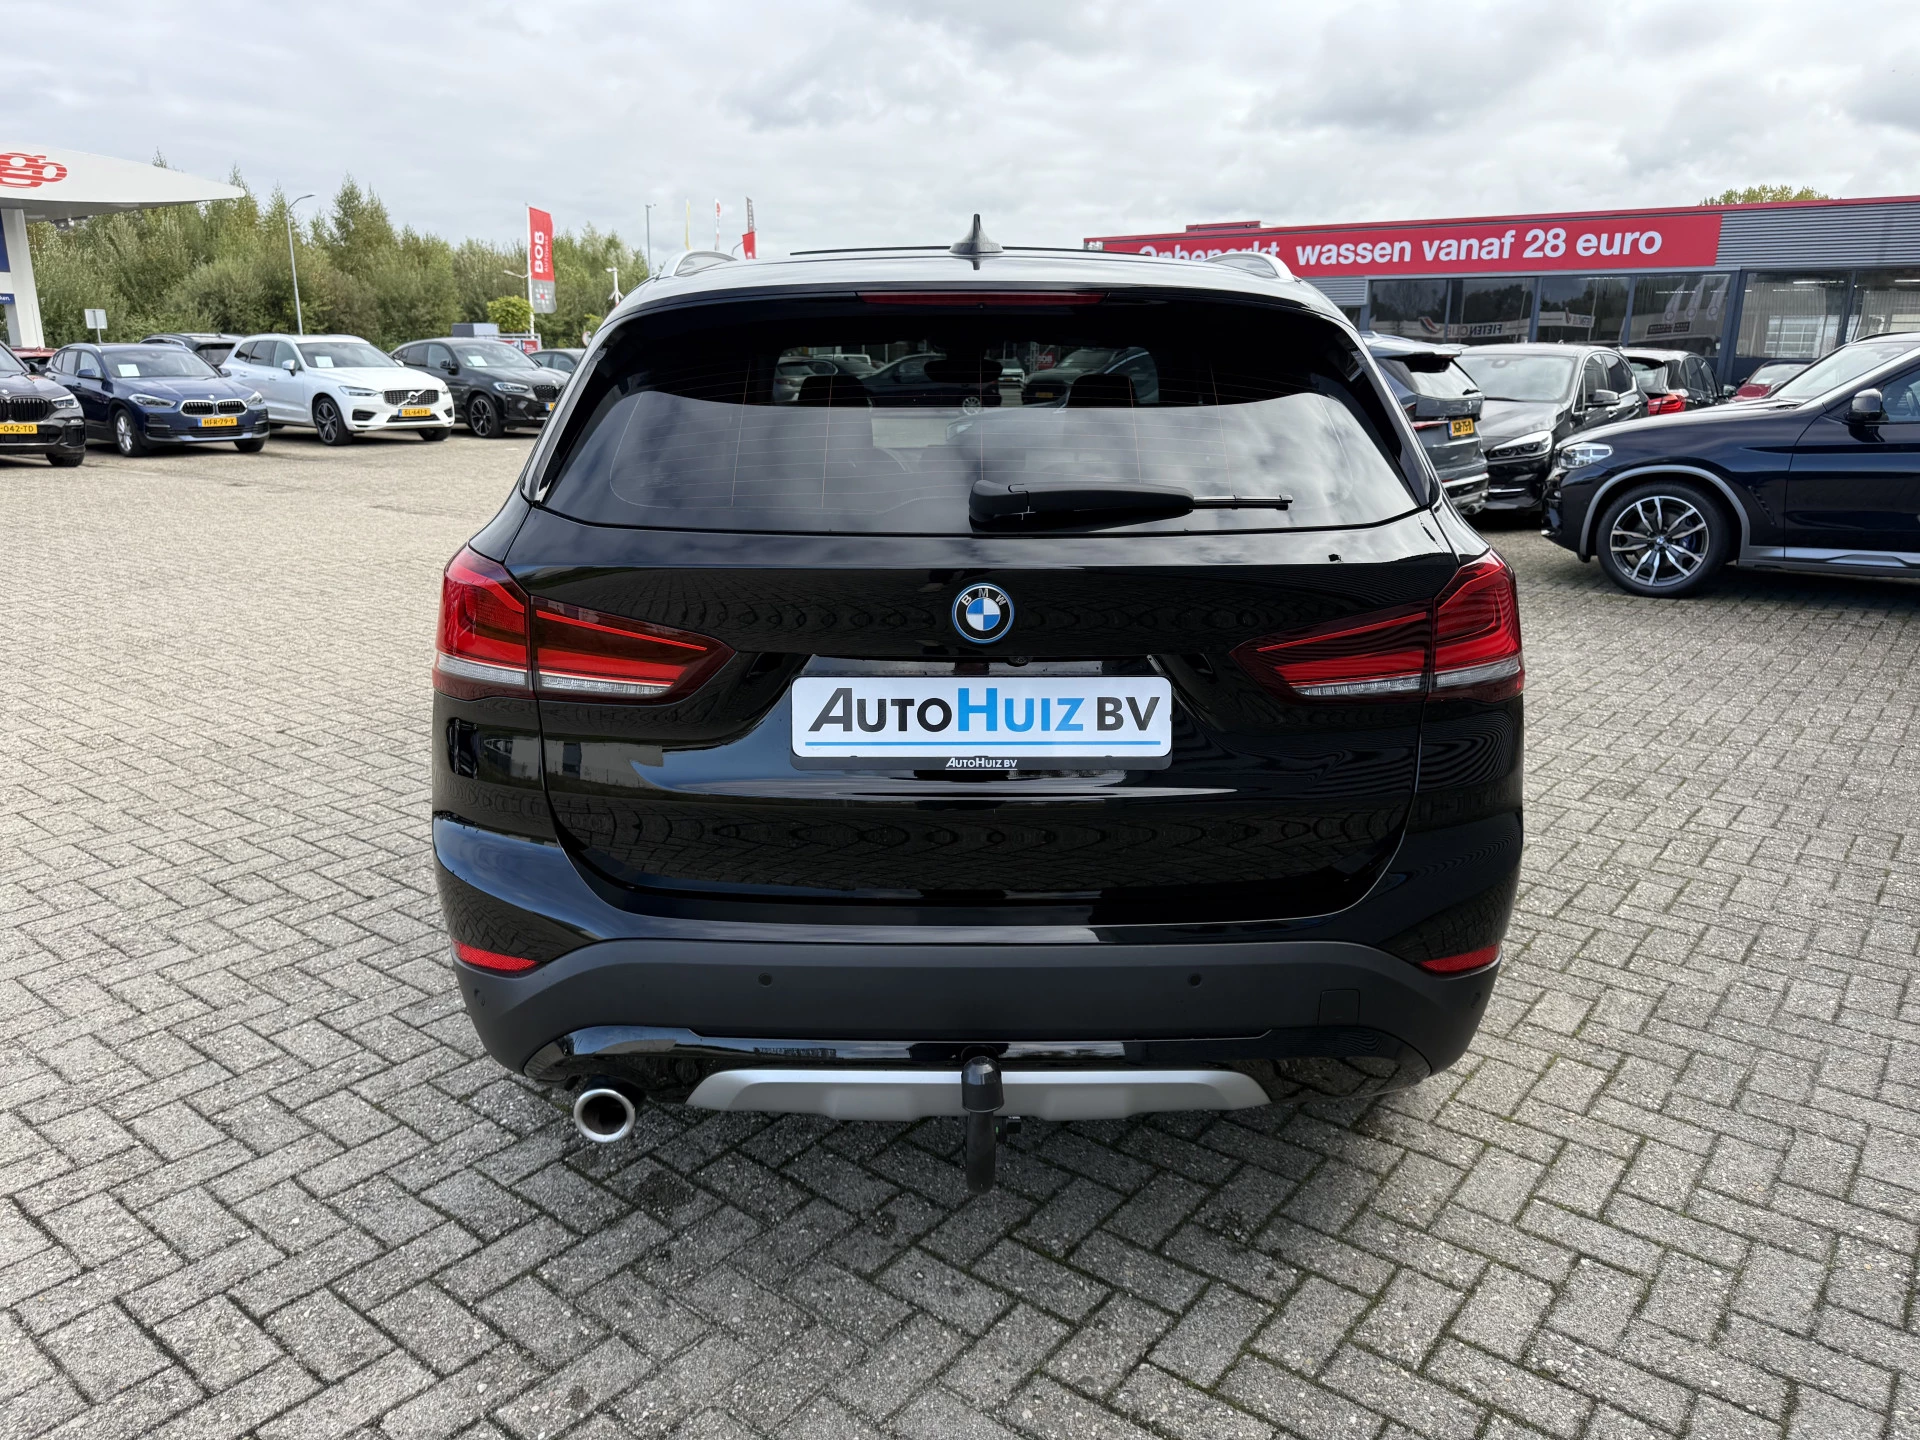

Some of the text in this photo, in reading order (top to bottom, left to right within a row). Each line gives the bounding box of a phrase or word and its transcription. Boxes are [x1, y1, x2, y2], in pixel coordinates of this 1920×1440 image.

[534, 231, 545, 274] BOB
[1139, 227, 1663, 266] Obekt wassen vanaf 28 euro
[961, 587, 1007, 606] BMW
[1096, 696, 1161, 732] BV
[1003, 759, 1018, 768] BV
